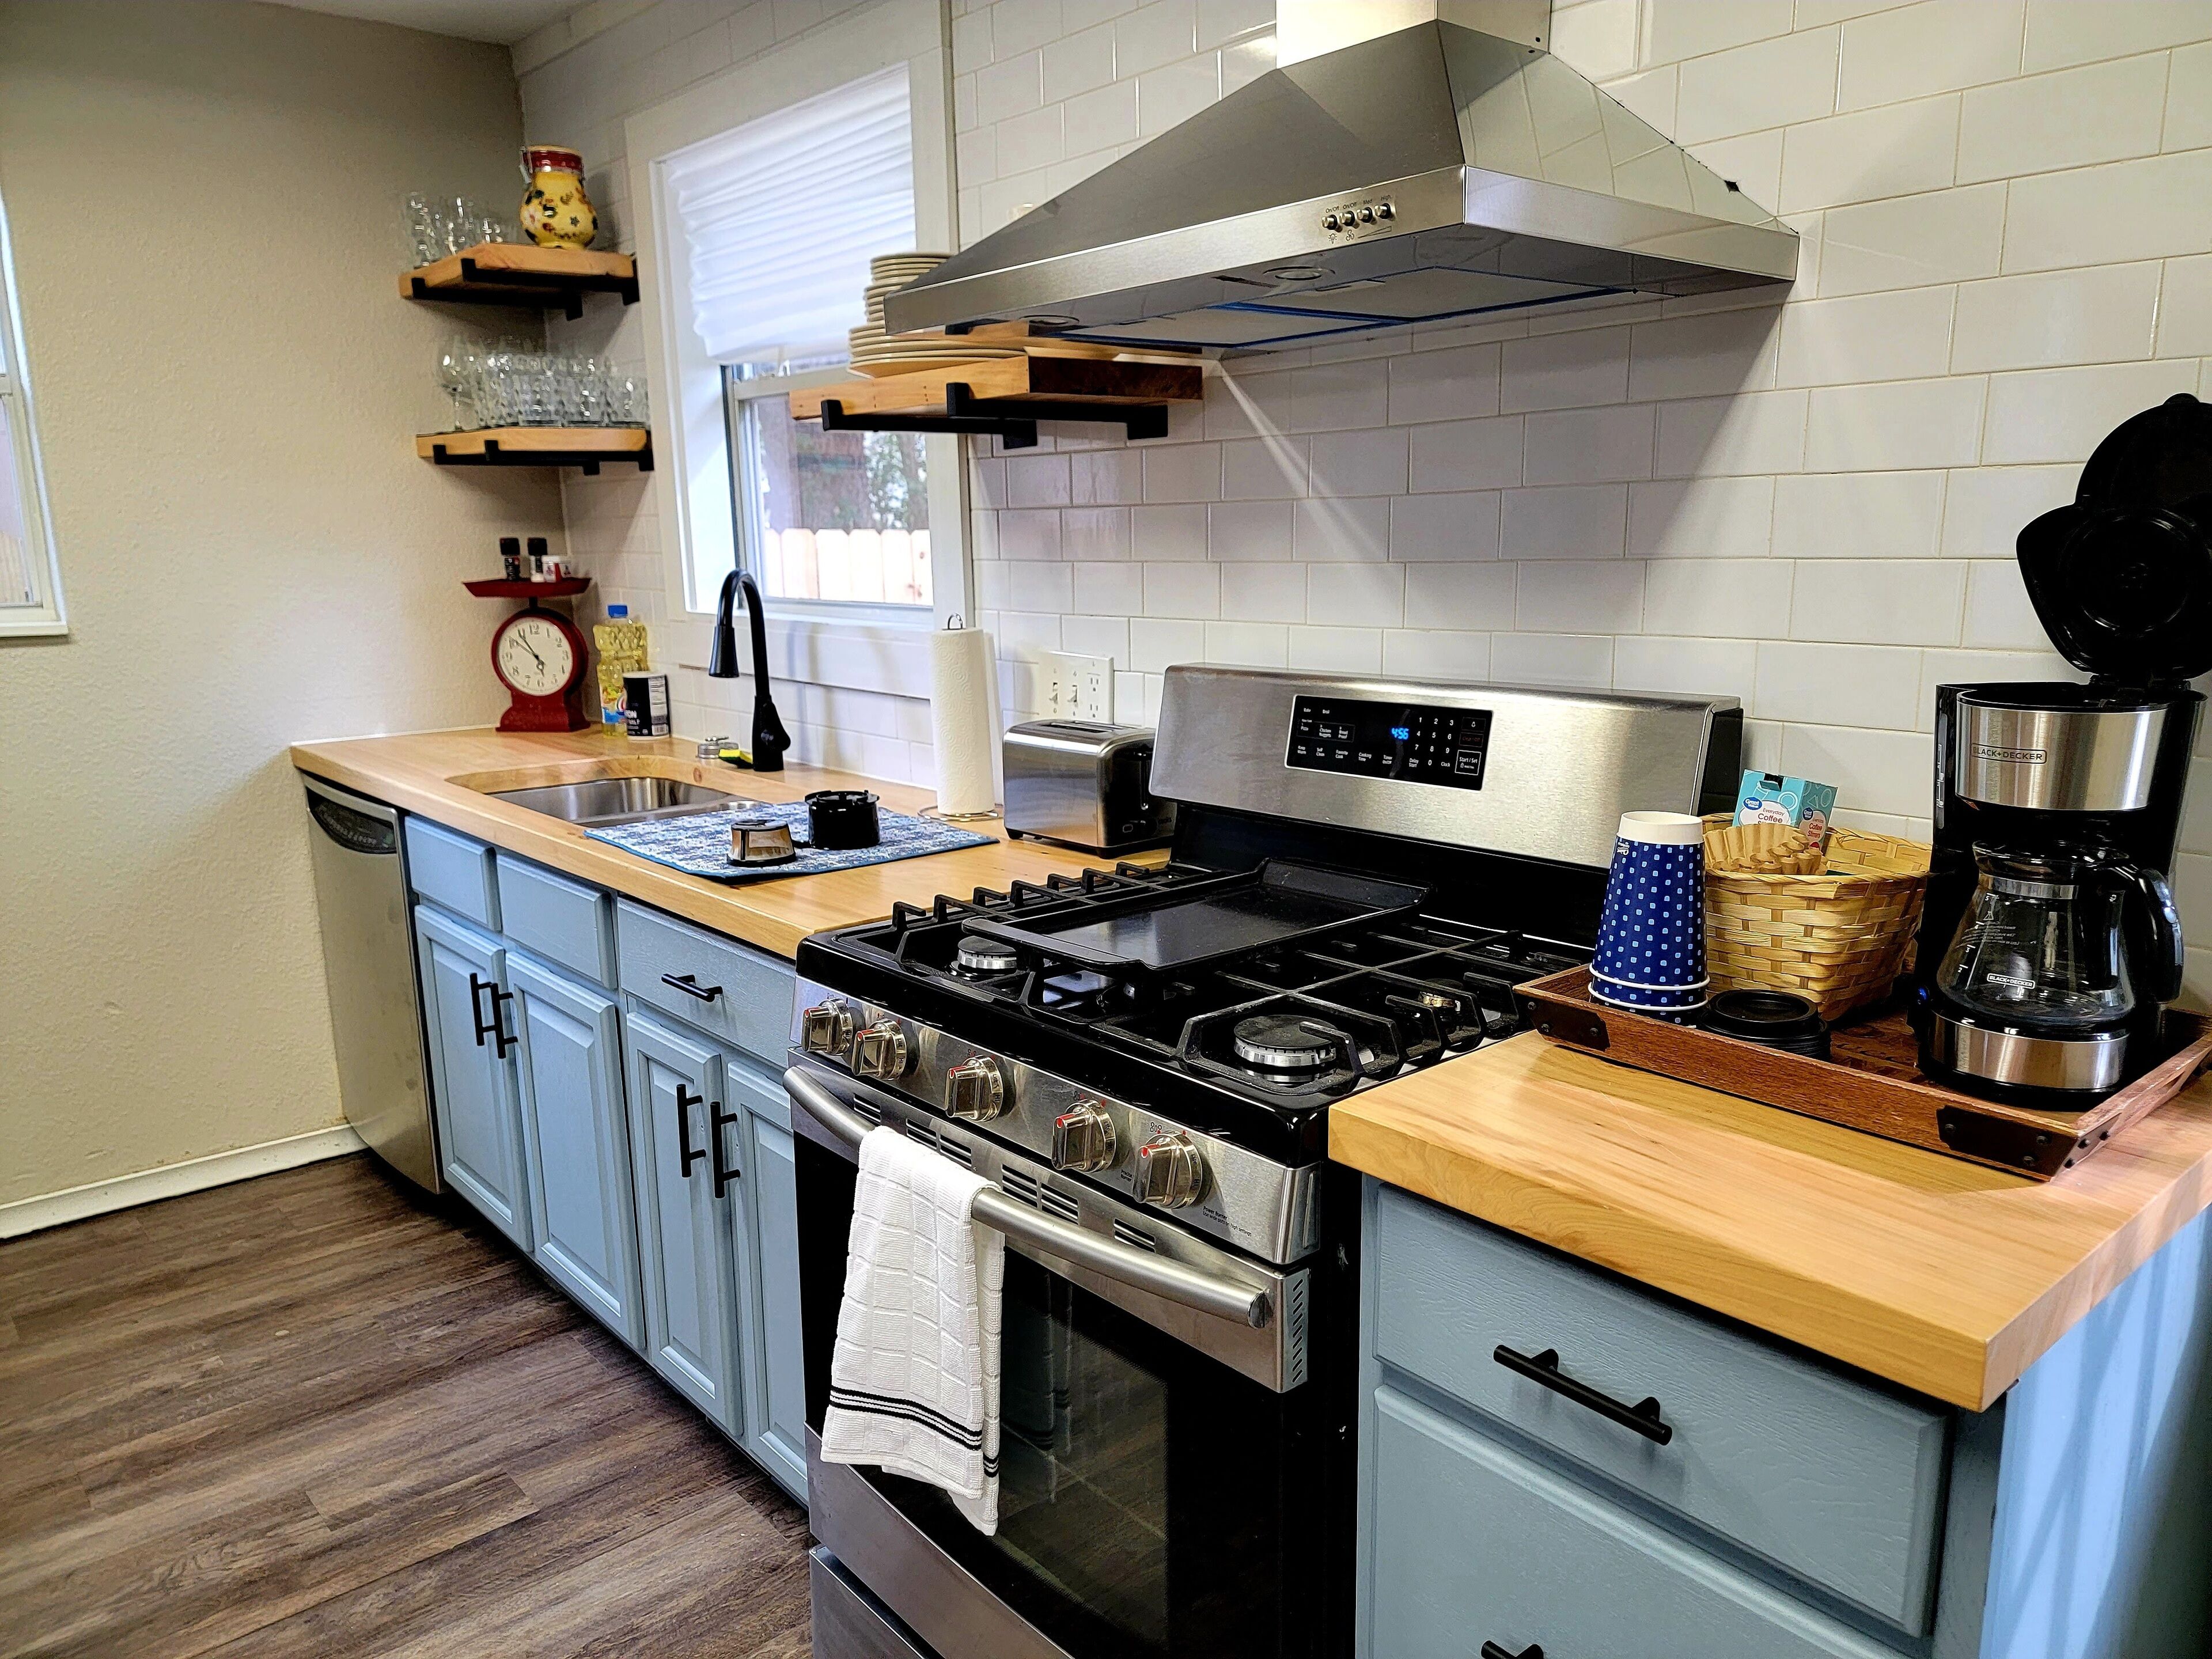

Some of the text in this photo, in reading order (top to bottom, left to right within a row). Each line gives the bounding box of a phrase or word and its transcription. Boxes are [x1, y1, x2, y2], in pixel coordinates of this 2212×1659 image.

[1973, 747, 2043, 760] BLACK+DECKER
[1763, 808, 1785, 816] Everyday
[1758, 813, 1783, 824] Coffee
[1809, 823, 1823, 831] Coffee
[1989, 975, 2033, 987] BLACK+DECKER
[1203, 1206, 1215, 1214] Power
